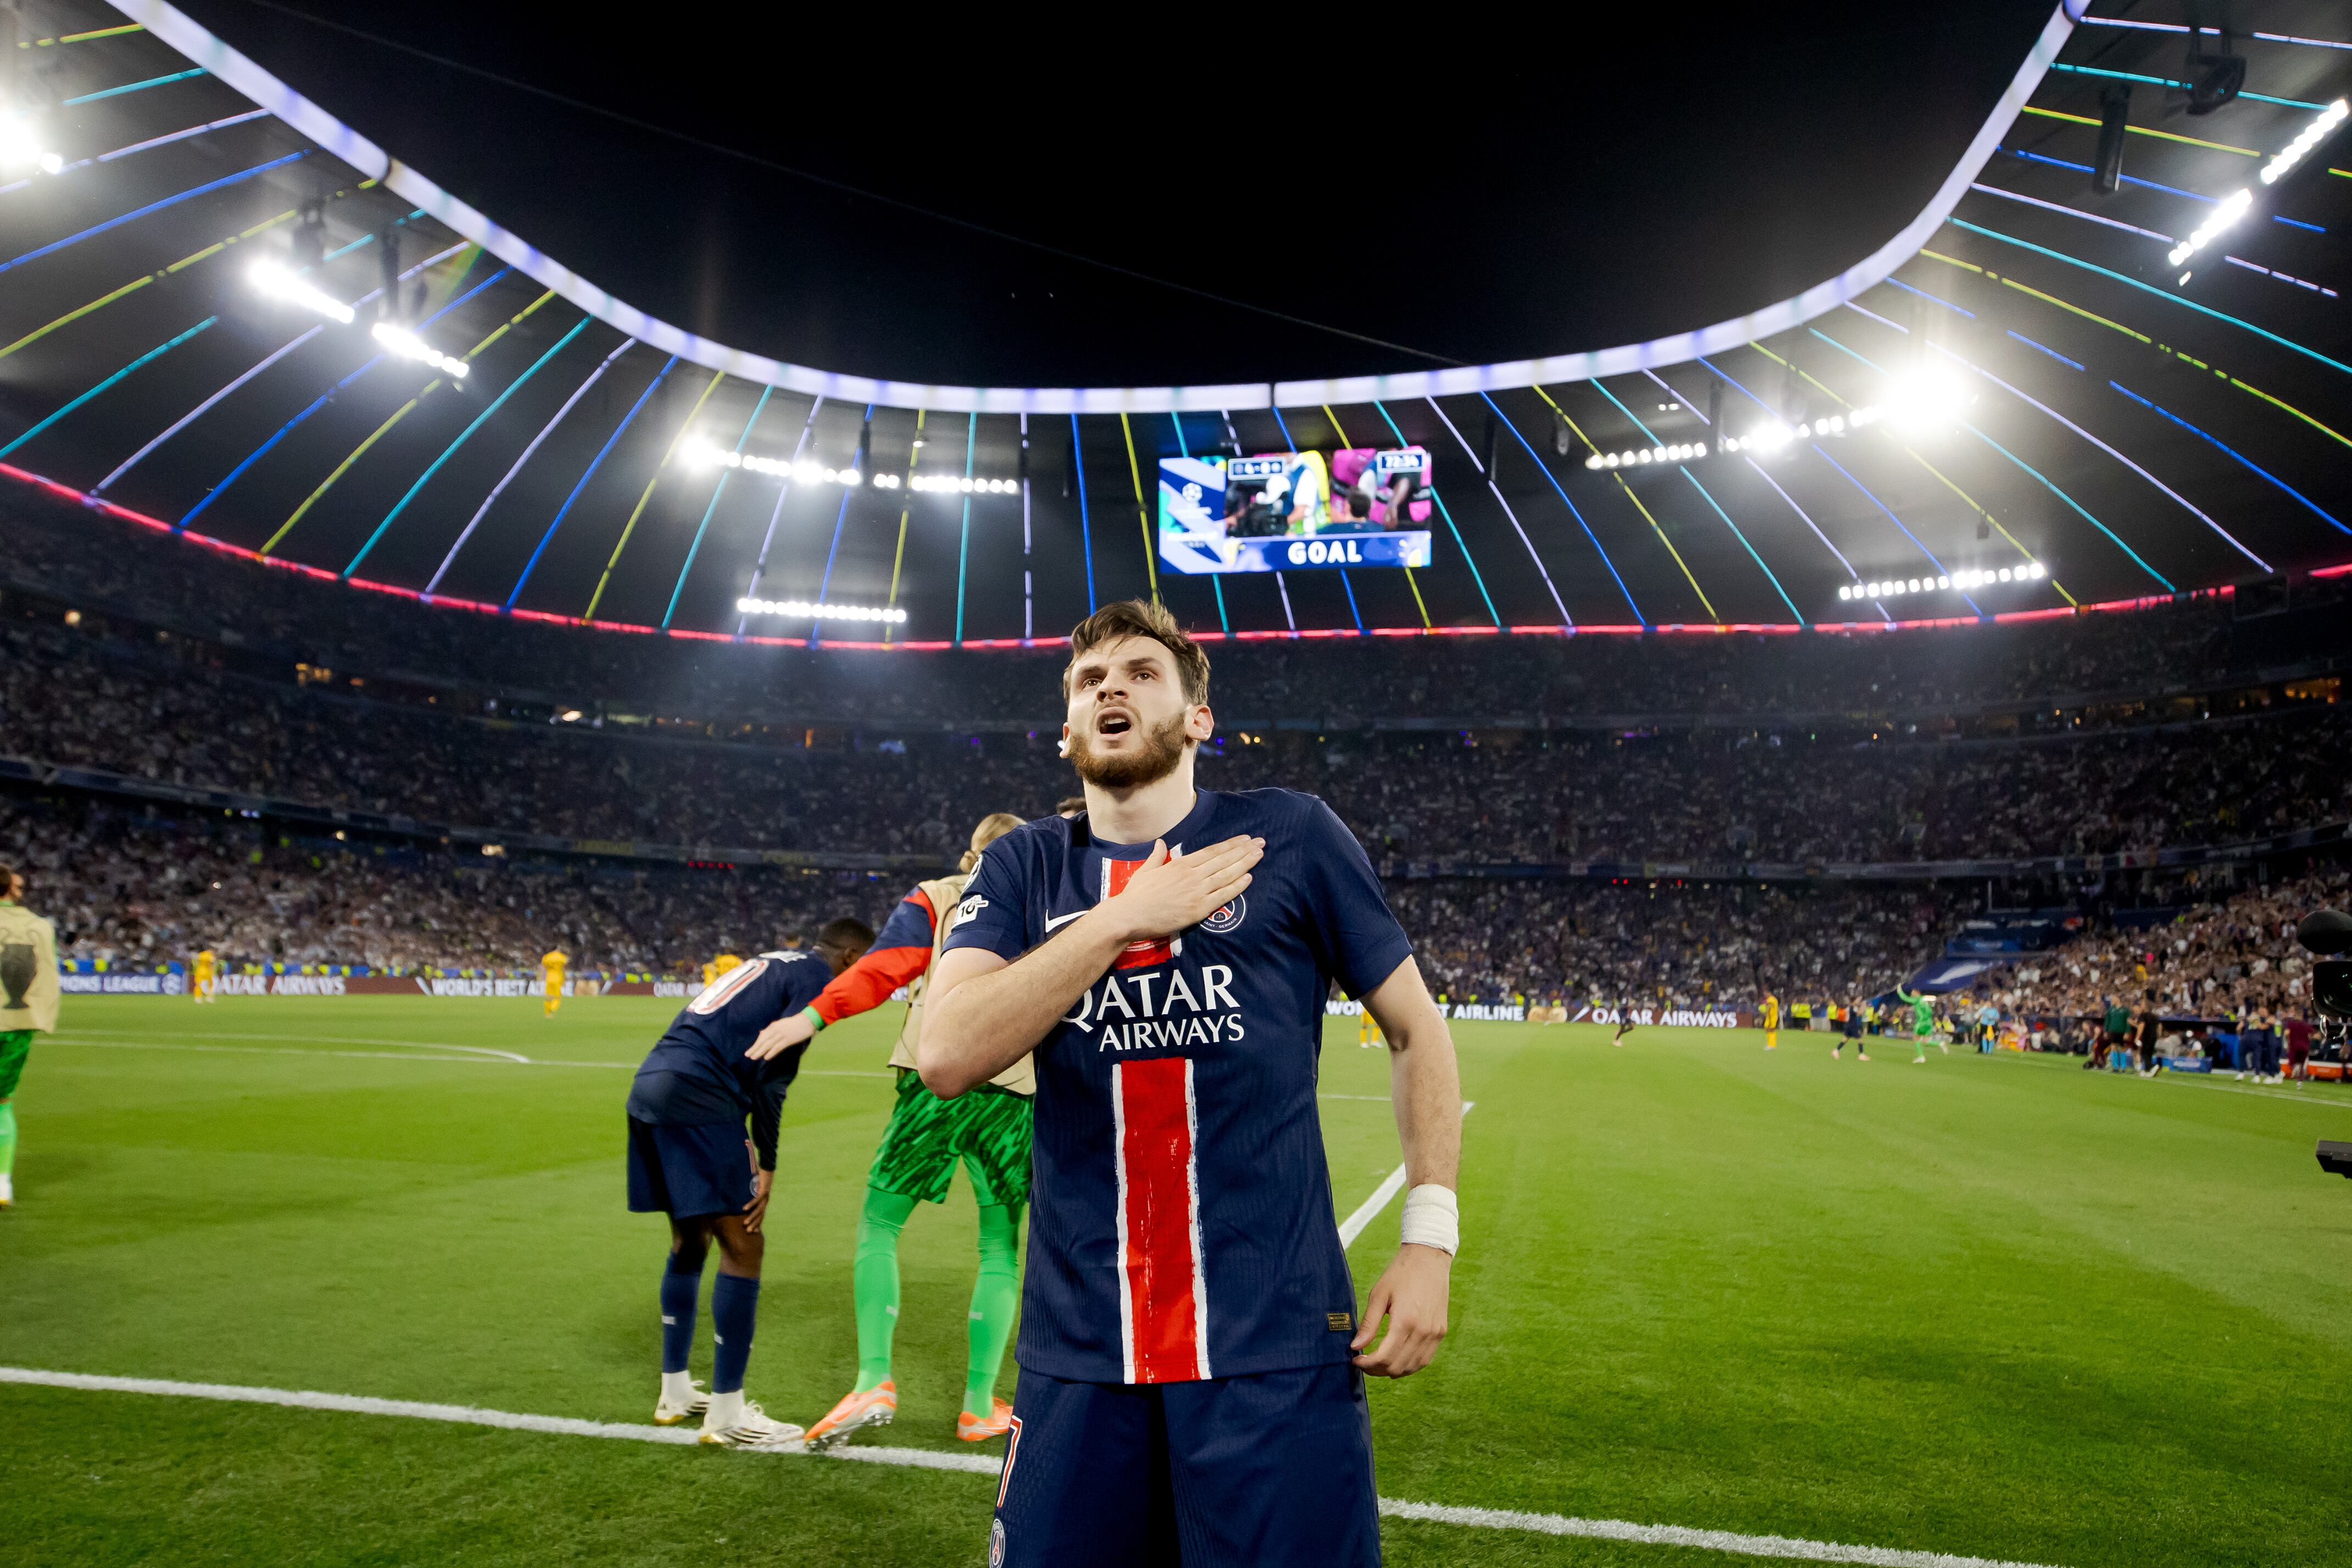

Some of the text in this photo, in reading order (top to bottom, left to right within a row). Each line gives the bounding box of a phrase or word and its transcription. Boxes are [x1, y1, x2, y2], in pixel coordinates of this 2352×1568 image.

[1288, 540, 1362, 565] GOAL
[961, 902, 976, 917] 10
[1219, 918, 1238, 929] GERMAIN
[270, 975, 347, 996] AIRWAYS
[431, 978, 494, 997] WORLD'S
[494, 979, 528, 997] BEST
[1453, 1004, 1524, 1022] AIRLINE
[1592, 1007, 1738, 1029] QAAR AIRWAYS
[1099, 1014, 1244, 1052] AIRWAYS
[997, 1415, 1023, 1508] 7
